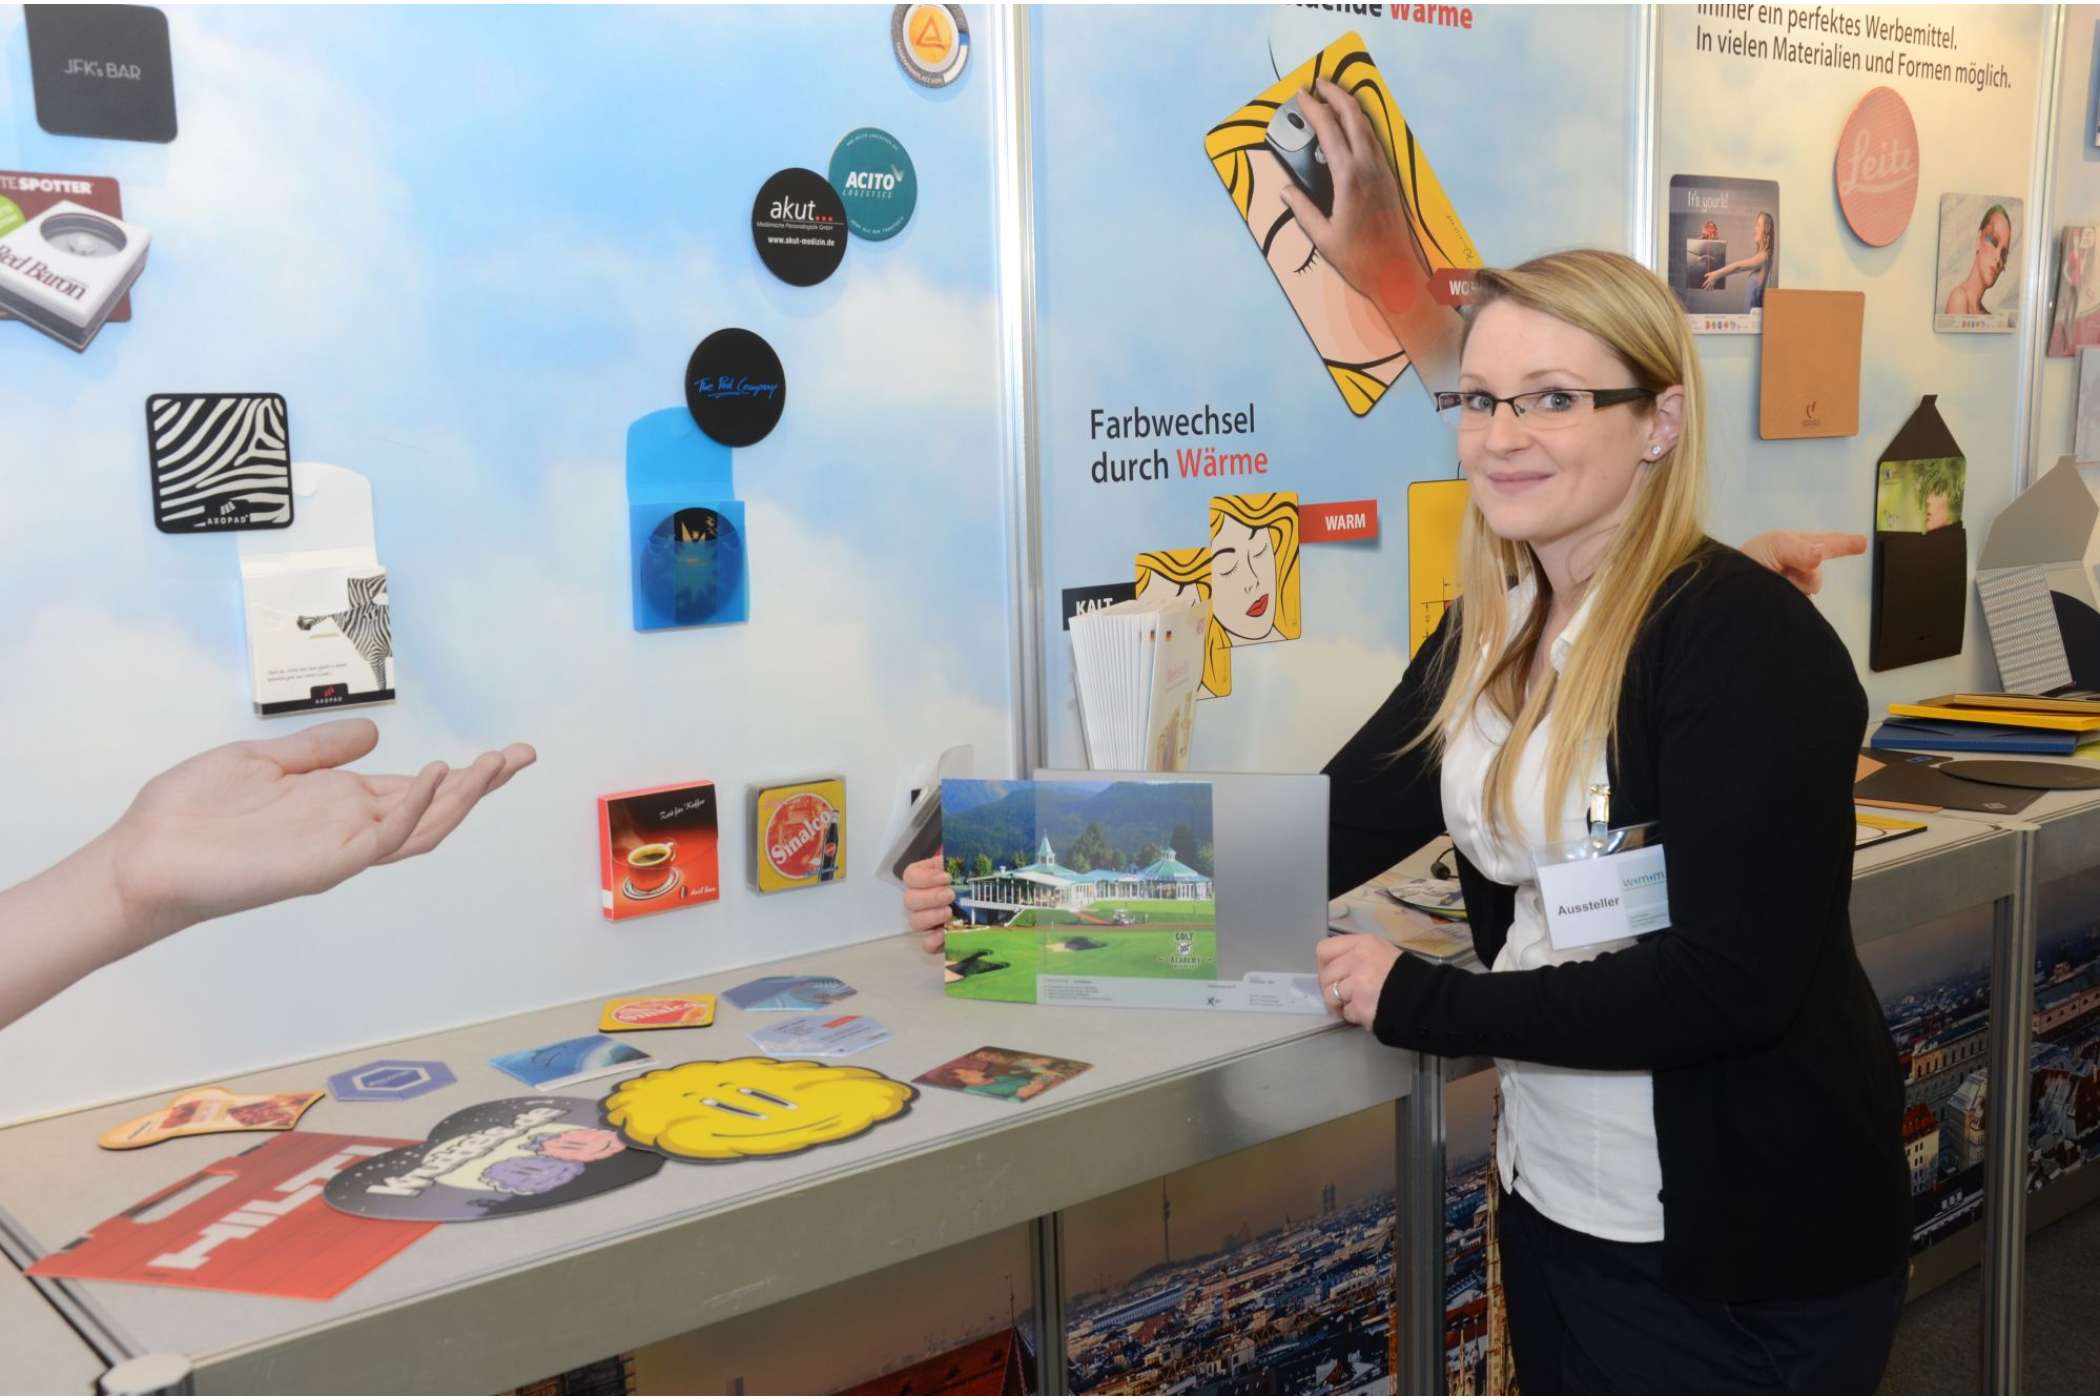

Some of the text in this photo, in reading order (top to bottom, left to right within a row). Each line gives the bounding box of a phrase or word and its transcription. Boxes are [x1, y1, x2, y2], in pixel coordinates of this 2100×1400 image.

[1758, 4, 1783, 25] ein
[1786, 6, 1861, 37] perfektes
[1865, 14, 1957, 51] Werbemittel.
[106, 62, 141, 80] BAR
[1696, 25, 2012, 92] In vielen Materialien und Formen möglich.
[845, 171, 895, 191] ACITO
[25, 260, 87, 301] Baron
[1091, 402, 1255, 440] Farbwechsel
[1091, 447, 1268, 484] durch Wärme
[1324, 512, 1367, 531] WARM
[771, 811, 831, 864] Sinalco
[1558, 896, 1620, 917] Aussteller
